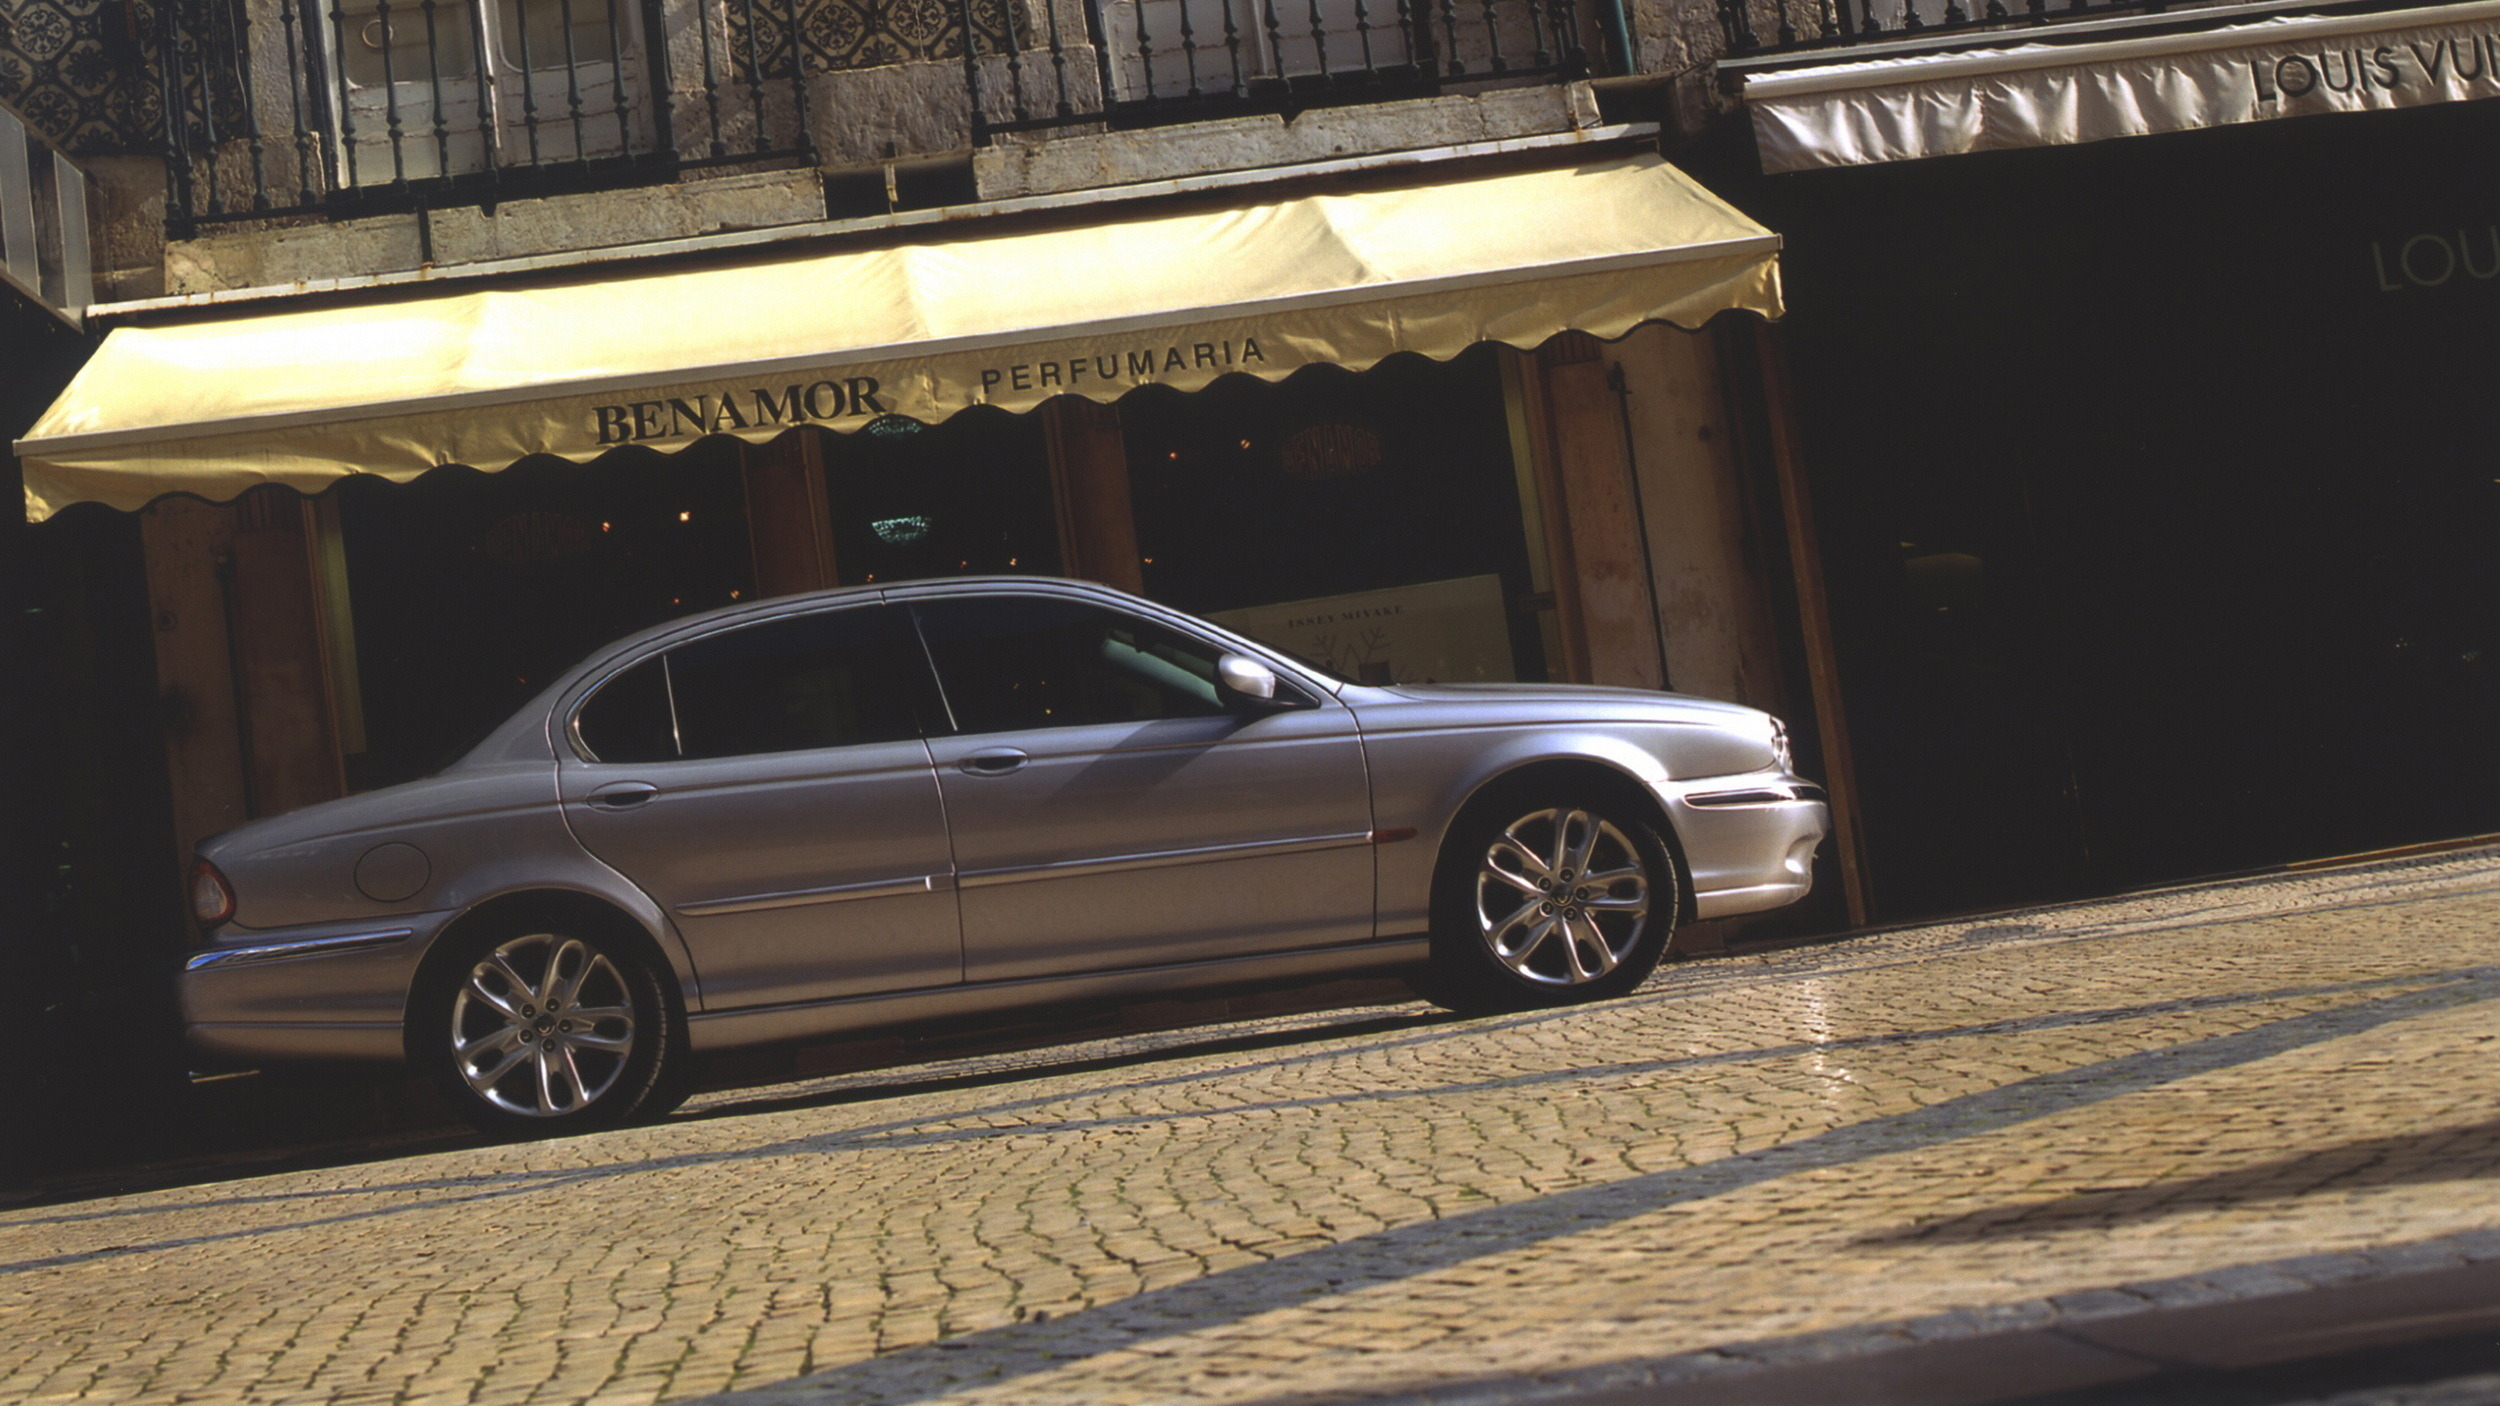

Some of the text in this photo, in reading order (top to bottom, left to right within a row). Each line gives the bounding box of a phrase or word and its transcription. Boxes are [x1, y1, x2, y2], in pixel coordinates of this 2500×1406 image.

[2251, 33, 2500, 102] LOUIS VUI
[2372, 225, 2500, 292] LOU
[591, 337, 1265, 446] BENAMOR PERFUMARIA
